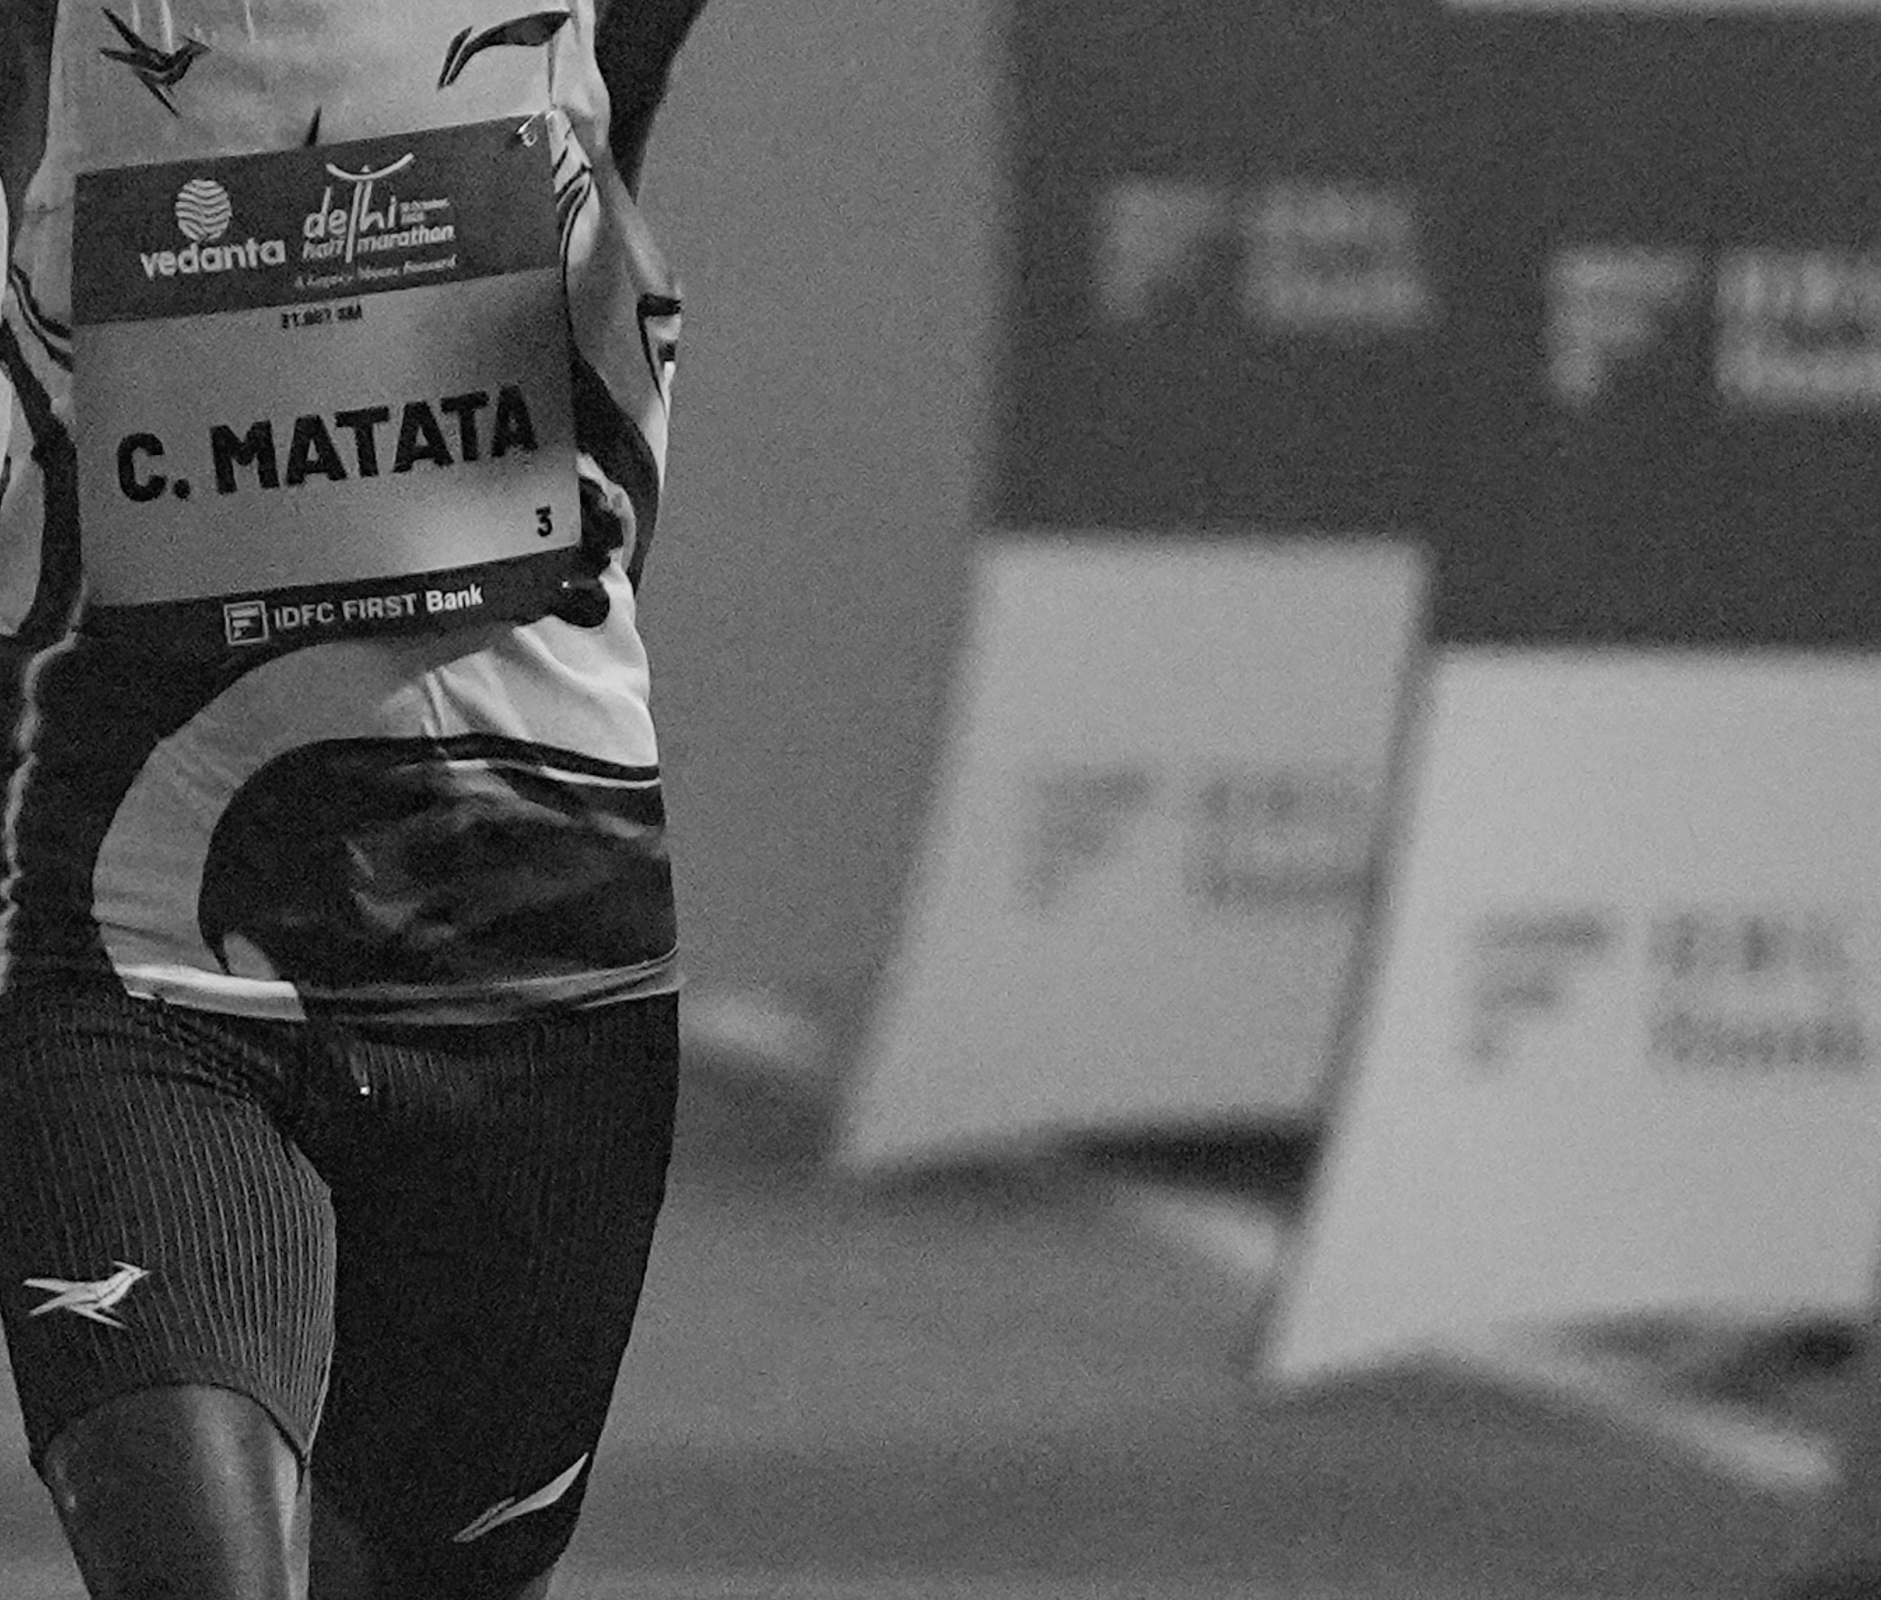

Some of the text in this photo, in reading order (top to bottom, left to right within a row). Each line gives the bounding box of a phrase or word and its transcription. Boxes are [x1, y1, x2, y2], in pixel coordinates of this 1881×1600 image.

[303, 180, 397, 264] delhi
[356, 224, 456, 253] marathon
[140, 237, 286, 279] vedanta
[117, 385, 538, 502] C. MATATA
[535, 506, 553, 538] 3
[273, 583, 484, 629] IDFC FIRST Bank
